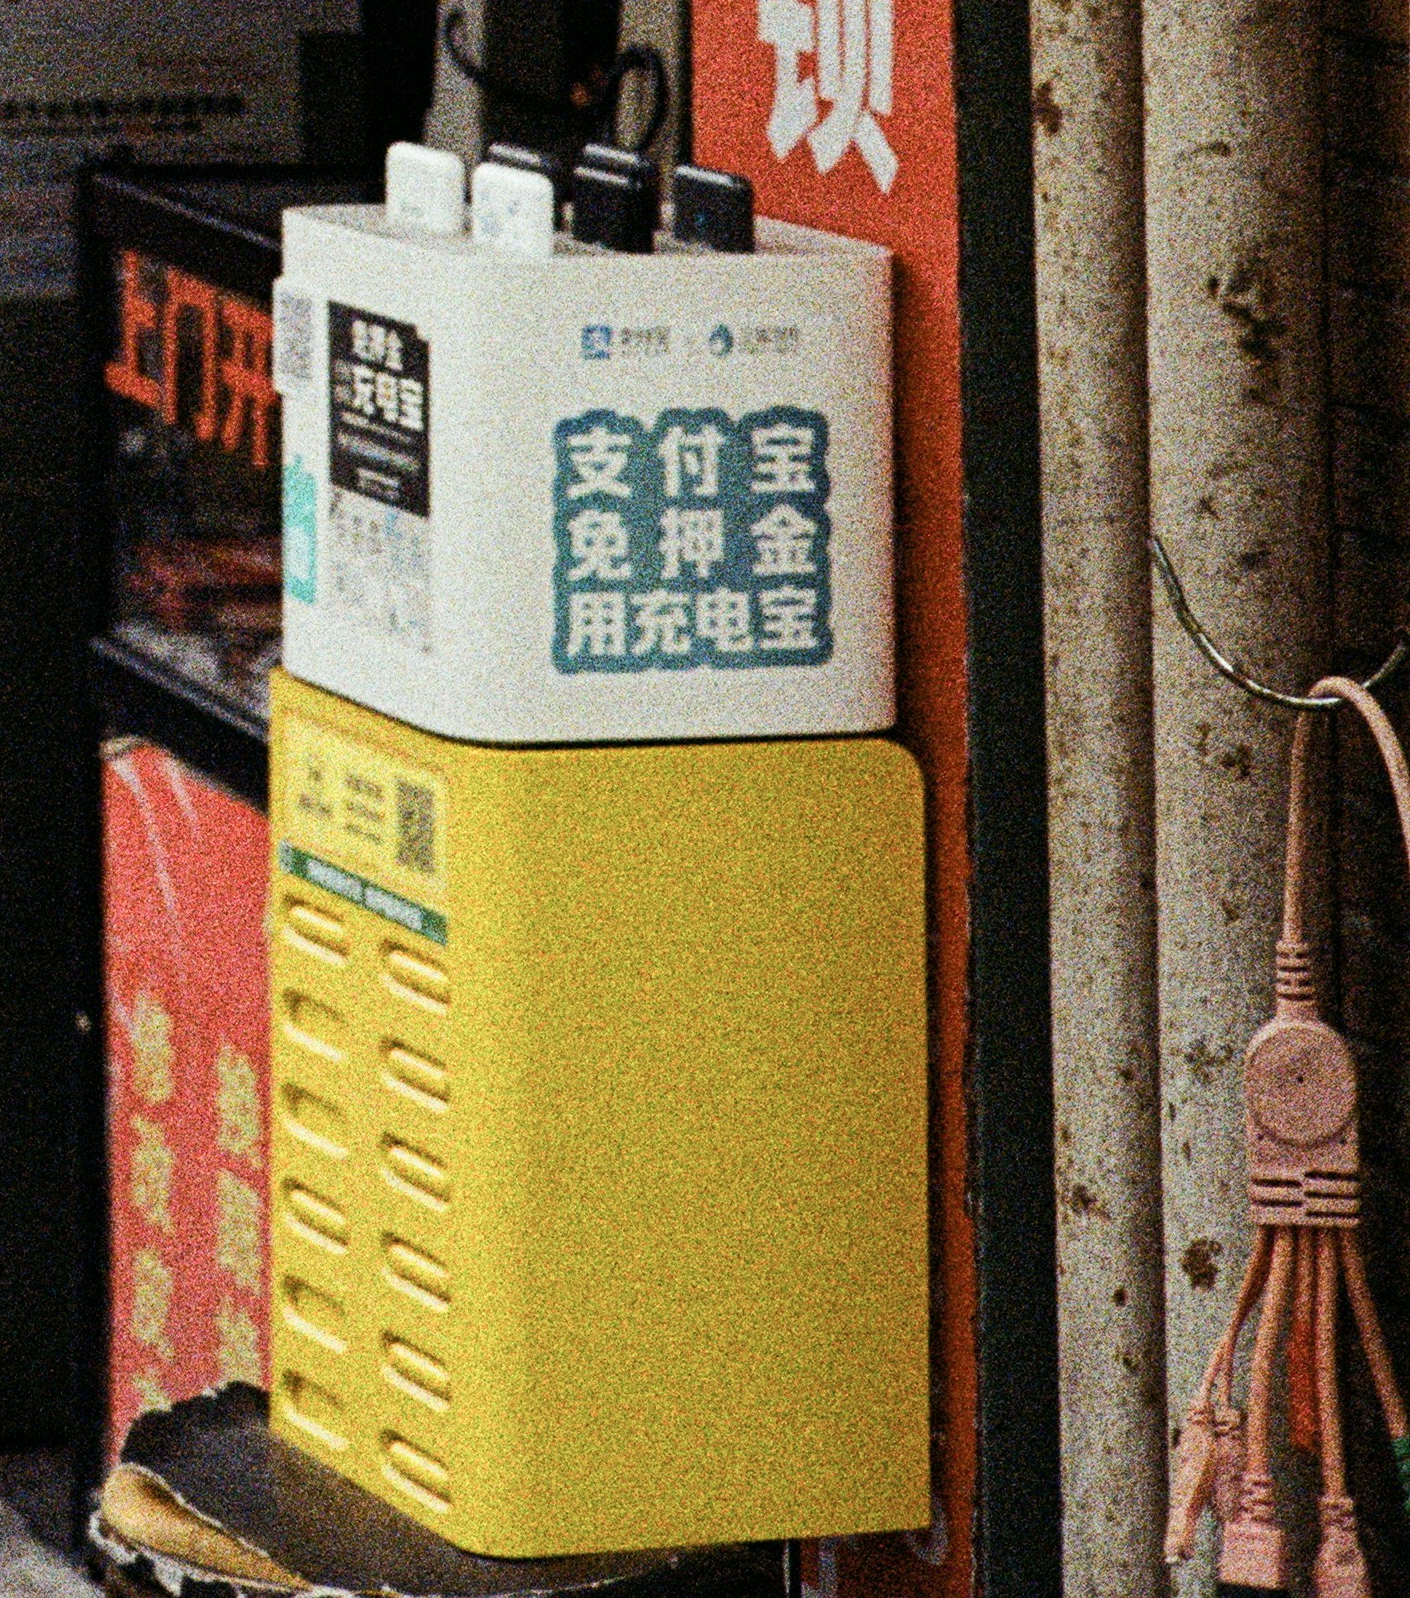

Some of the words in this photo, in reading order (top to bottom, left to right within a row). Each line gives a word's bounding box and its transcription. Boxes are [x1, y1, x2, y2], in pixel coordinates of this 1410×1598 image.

[565, 423, 816, 499] 支付宝
[566, 506, 818, 580] 免押金
[564, 589, 820, 658] 用充电宝
